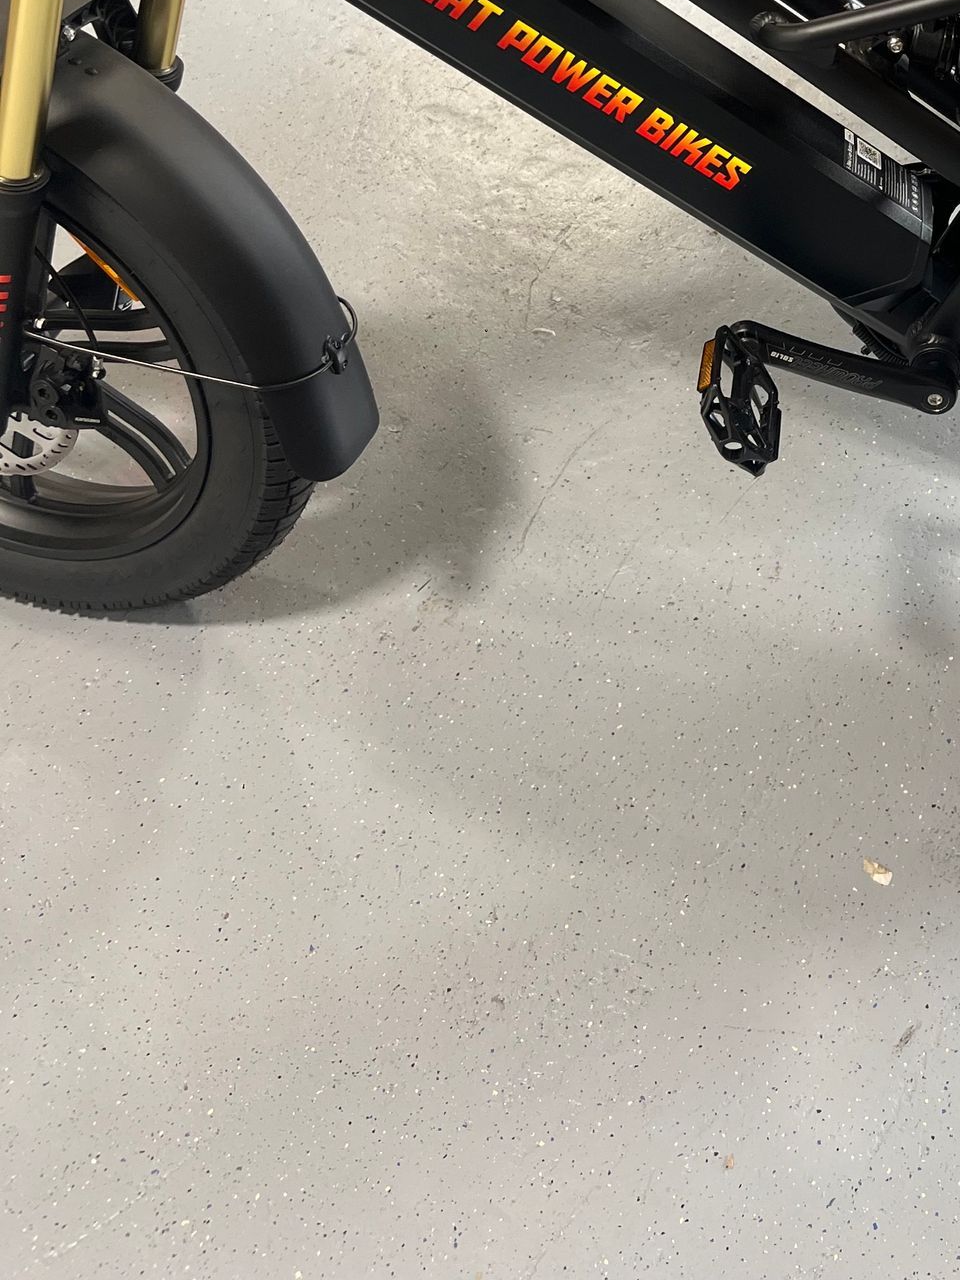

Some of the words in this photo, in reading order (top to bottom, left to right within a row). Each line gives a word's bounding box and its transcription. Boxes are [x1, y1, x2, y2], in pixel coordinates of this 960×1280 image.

[496, 19, 645, 123] POWER
[635, 106, 753, 191] BIKES
[770, 350, 795, 364] SOLID
